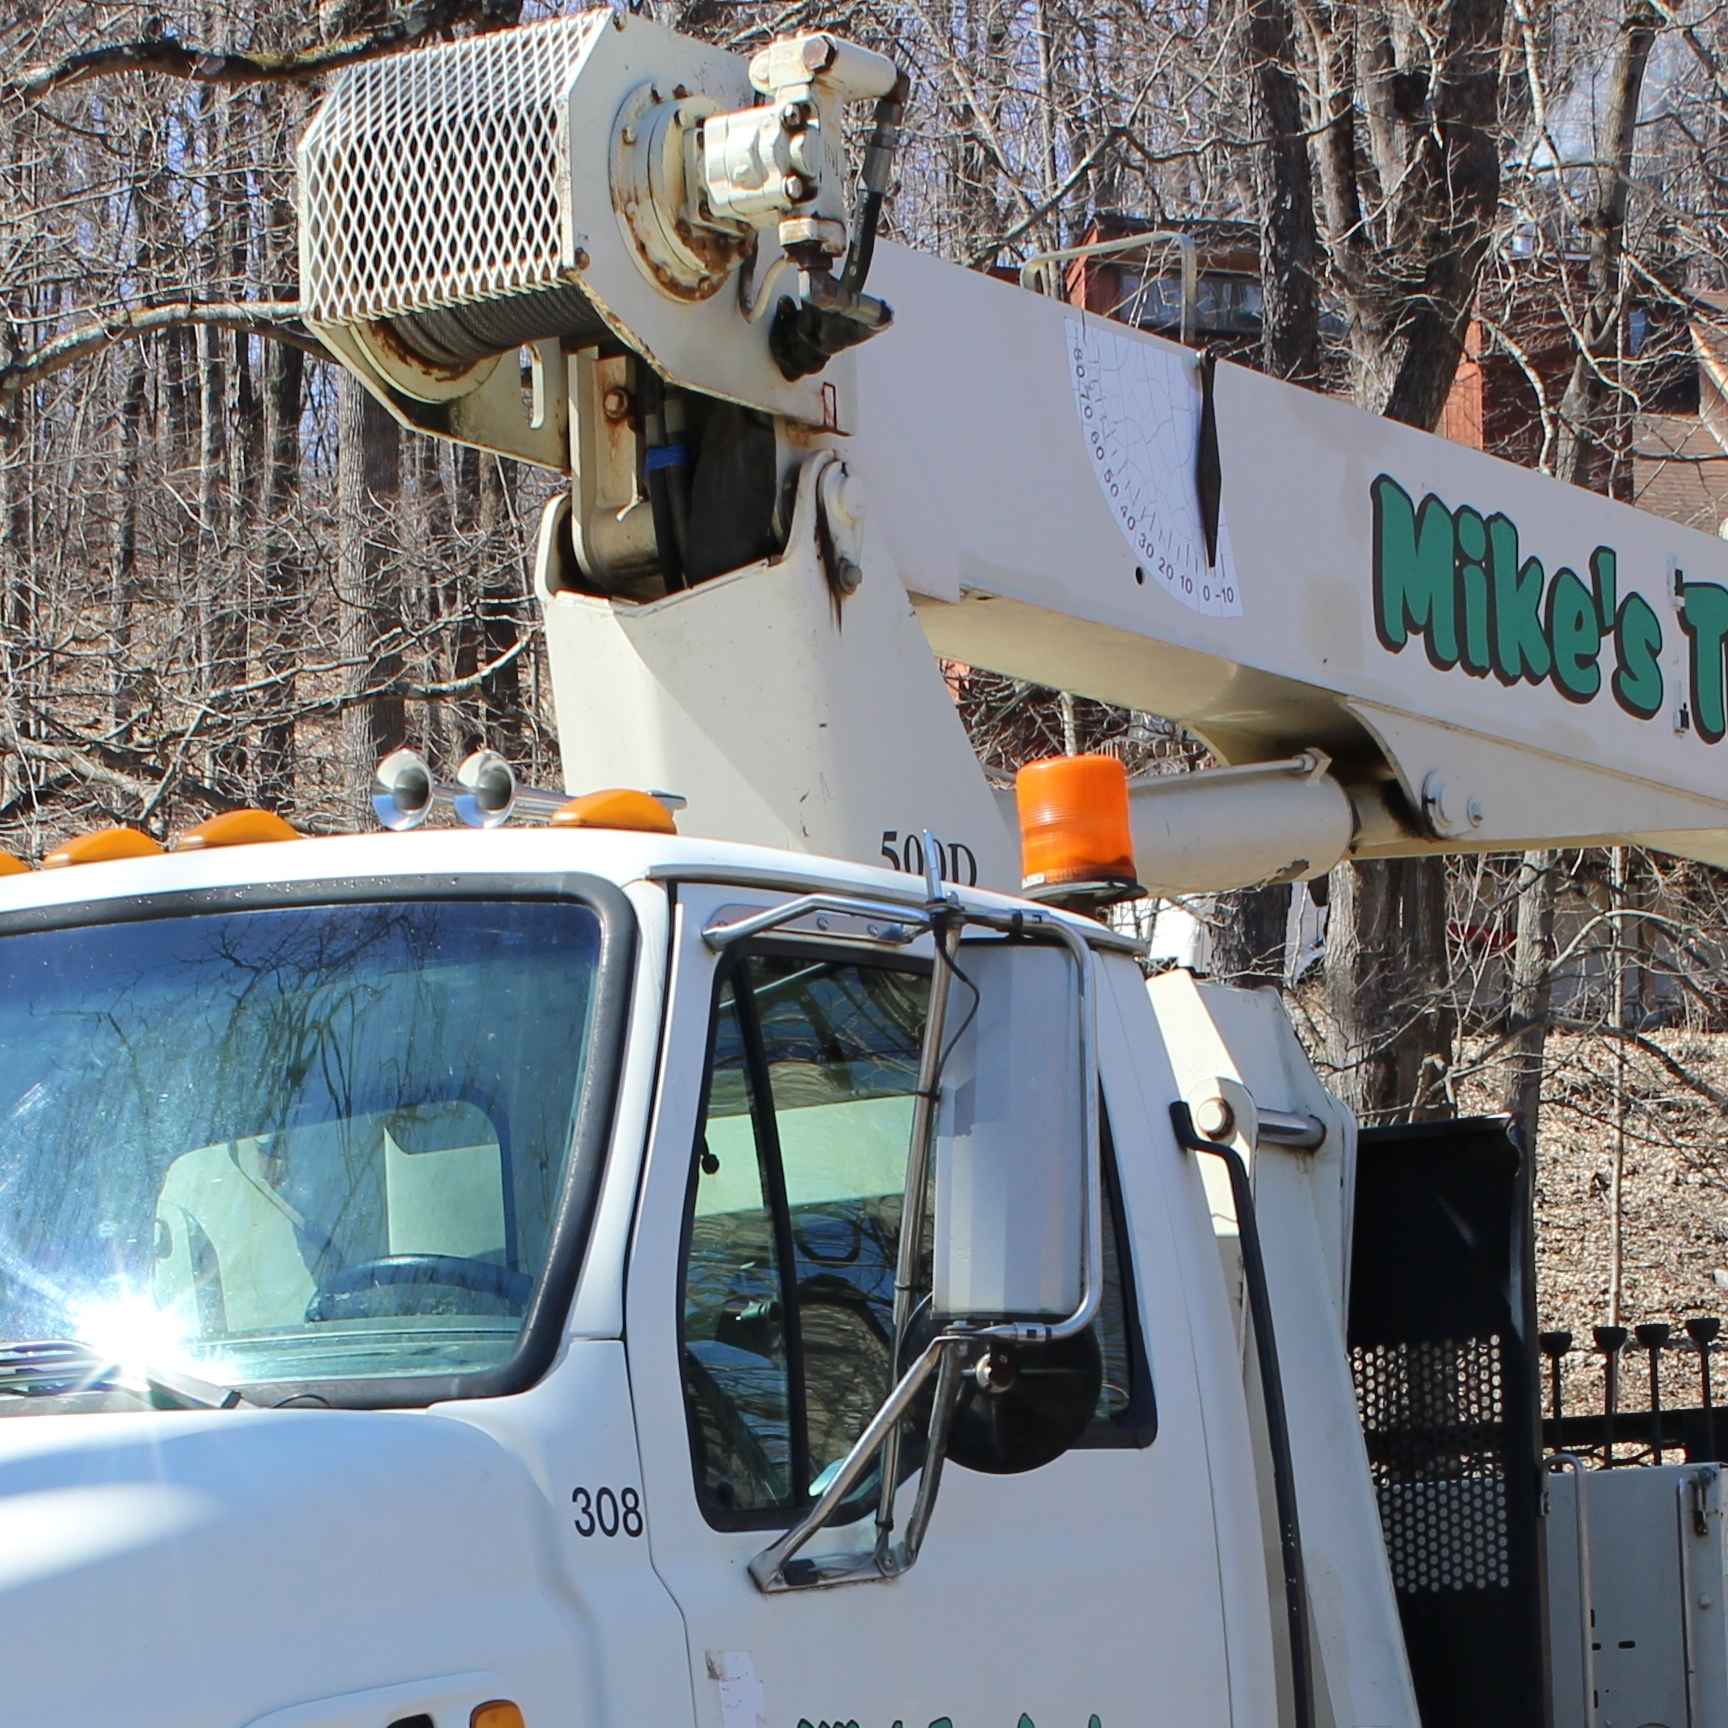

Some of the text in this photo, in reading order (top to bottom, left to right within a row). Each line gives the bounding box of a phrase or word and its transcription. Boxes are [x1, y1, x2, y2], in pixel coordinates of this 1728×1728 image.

[1138, 531, 1154, 559] 30
[1159, 557, 1174, 581] 20
[1181, 575, 1193, 595] 10
[1203, 584, 1210, 601] 0
[1370, 473, 1664, 720] Mike's
[572, 1487, 643, 1537] 308
